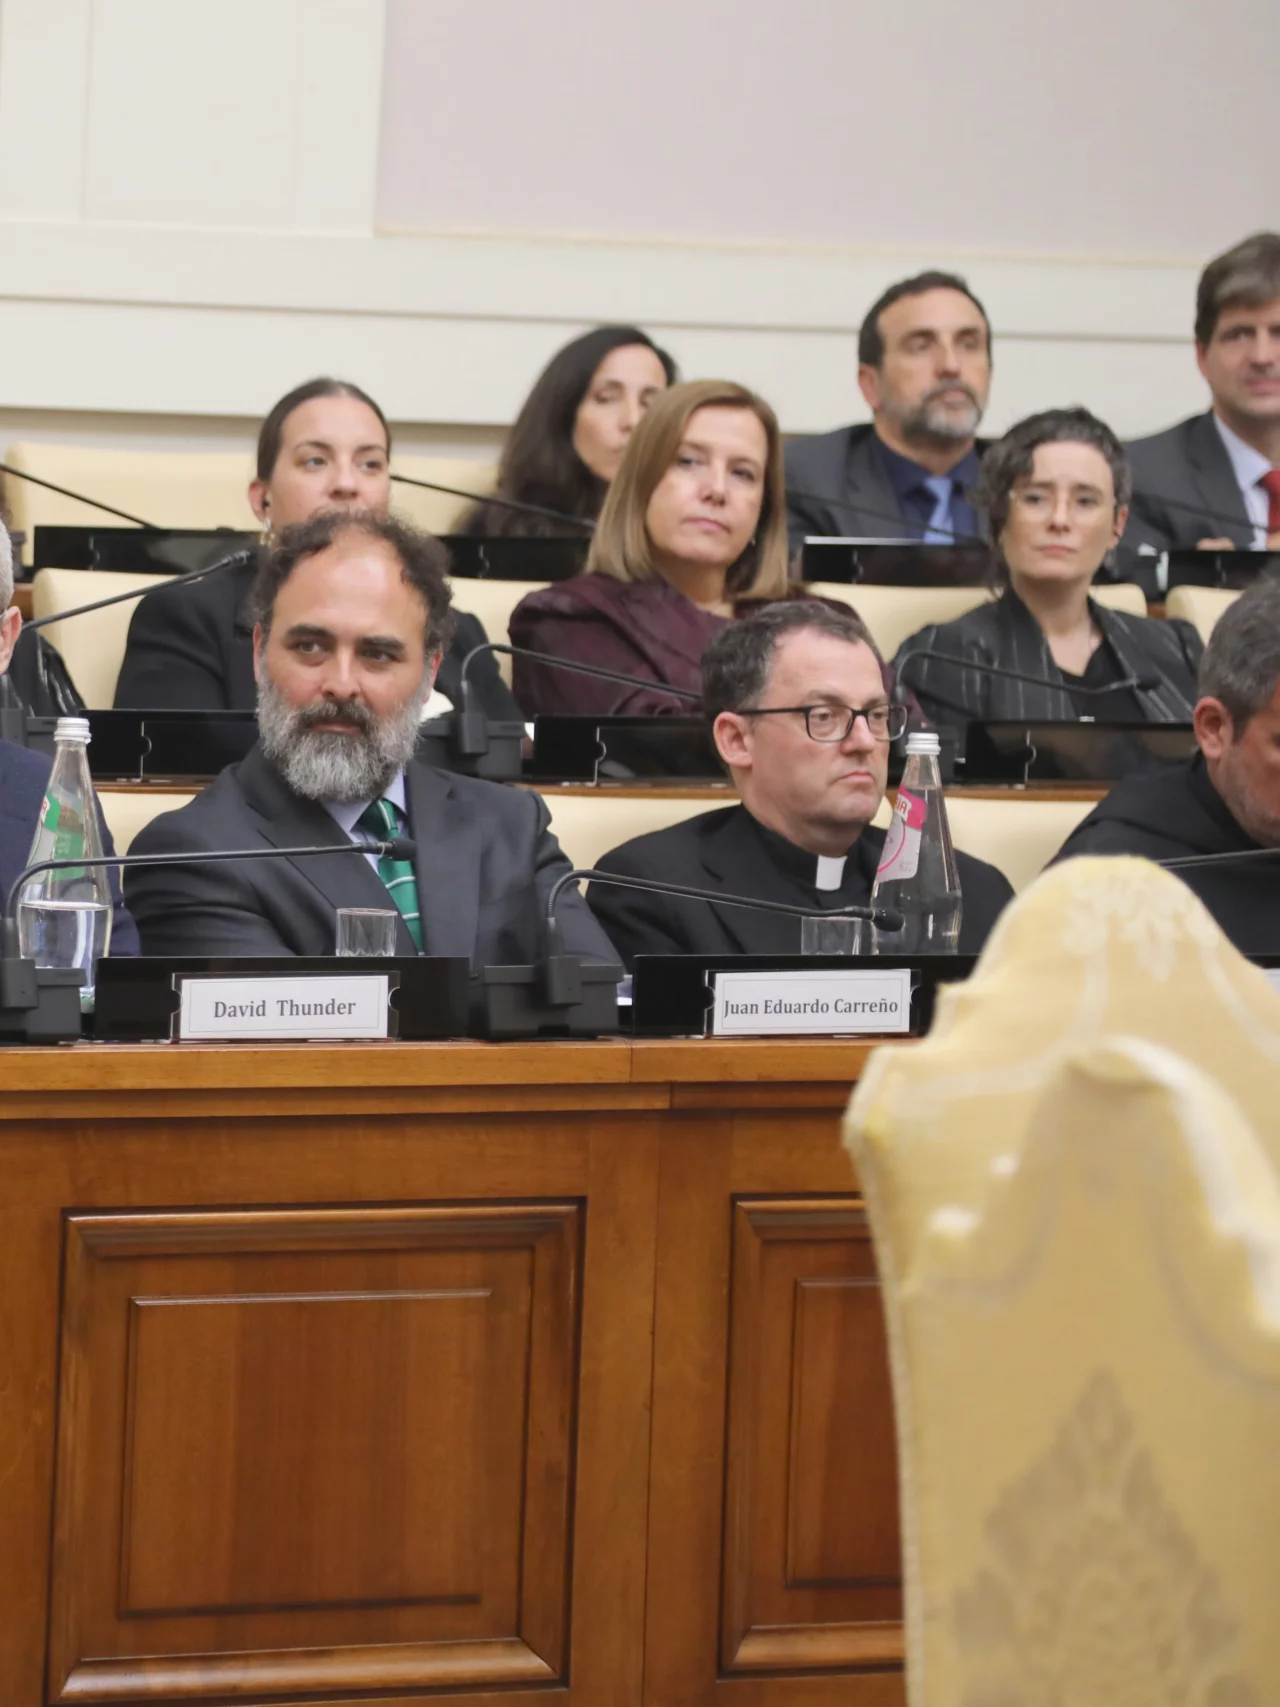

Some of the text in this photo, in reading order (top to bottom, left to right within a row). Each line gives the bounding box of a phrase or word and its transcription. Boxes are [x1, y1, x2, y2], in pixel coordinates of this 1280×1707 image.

[214, 998, 356, 1018] David Thunder
[723, 998, 898, 1019] Juan Eduardo Carreño
